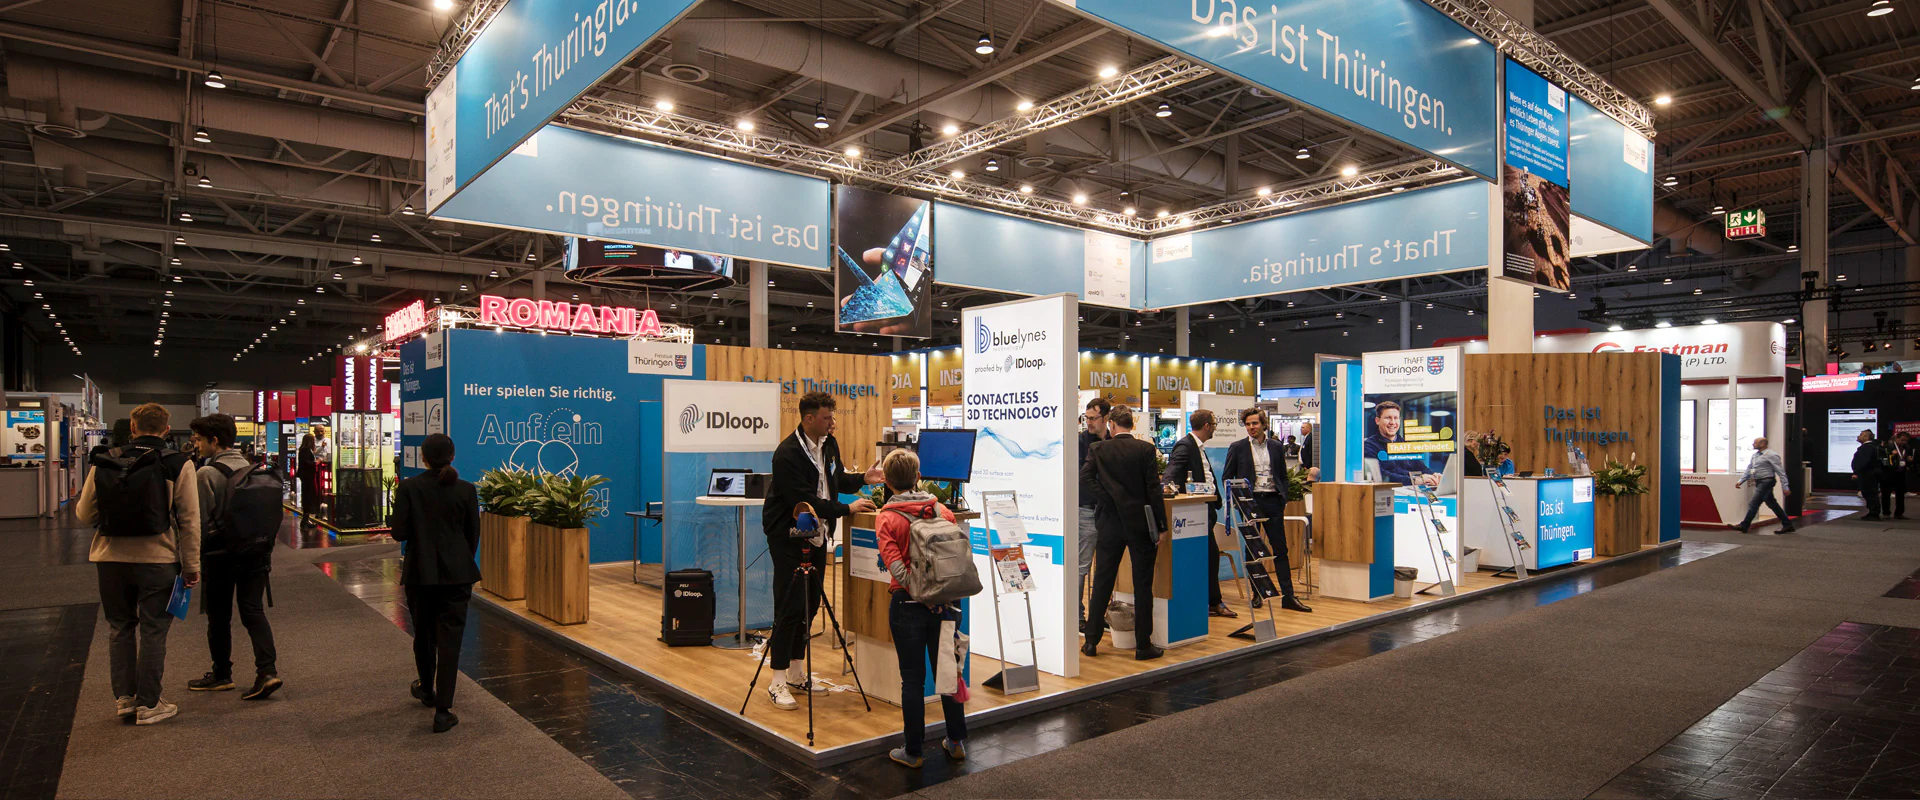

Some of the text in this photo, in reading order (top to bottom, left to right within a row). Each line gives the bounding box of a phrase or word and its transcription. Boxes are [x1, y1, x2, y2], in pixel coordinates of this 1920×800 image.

[484, 0, 638, 139] That's Thuringia.
[1271, 4, 1308, 72] ist
[1316, 28, 1453, 136] Thüringen.
[480, 295, 664, 337] ROMANIA
[993, 328, 1047, 349] bluelynes
[634, 356, 673, 368] Thüringen
[975, 364, 995, 374] proofed
[996, 364, 1003, 373] by
[1378, 364, 1424, 375] Thüringen
[1403, 356, 1424, 364] ThAFF
[1685, 356, 1727, 367] (P) LTD.
[345, 357, 355, 411] ROMANIA
[940, 368, 962, 387] IND
[463, 383, 616, 402] Hier spielen Sie richtig.
[802, 377, 880, 400] Thüringen.
[966, 391, 1039, 406] CONTACTLESS
[1307, 398, 1320, 408] riv
[966, 406, 1058, 421] 3D TECHNOLOGY
[1544, 405, 1601, 420] Das ist
[477, 413, 543, 446] Auf
[551, 414, 602, 445] ein
[1544, 427, 1635, 446] Thüringen.
[1540, 499, 1564, 516] Das ist
[1540, 523, 1577, 542] Thüringen.
